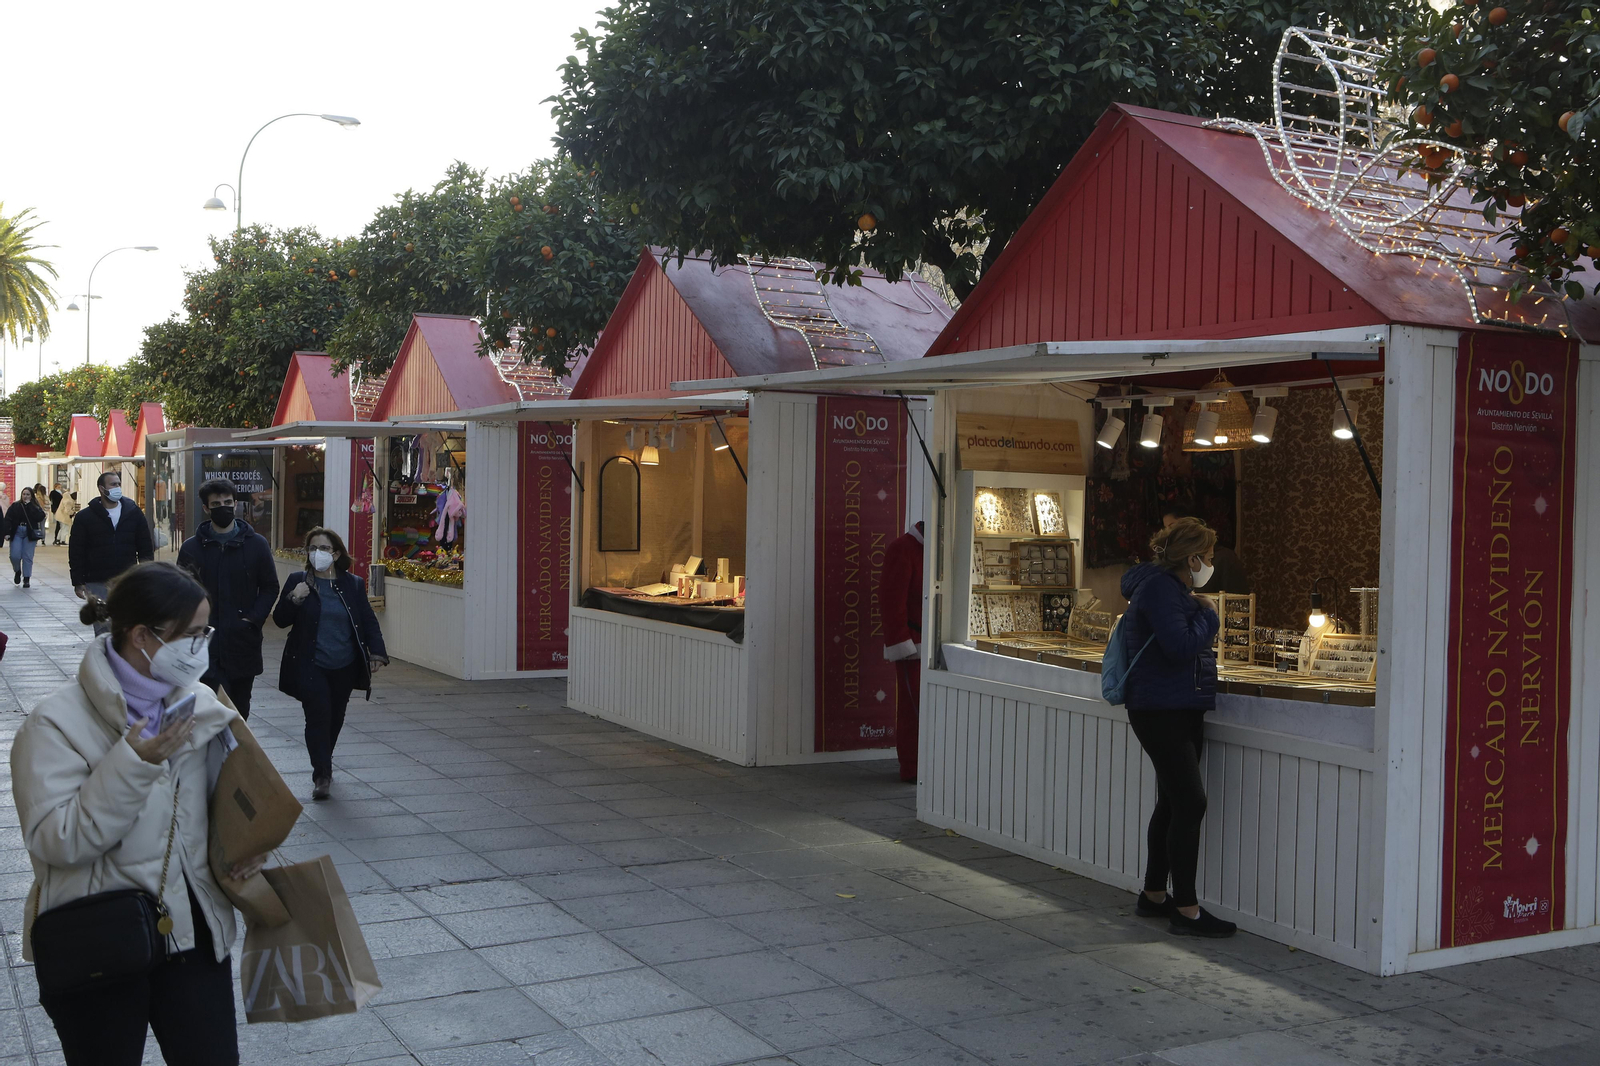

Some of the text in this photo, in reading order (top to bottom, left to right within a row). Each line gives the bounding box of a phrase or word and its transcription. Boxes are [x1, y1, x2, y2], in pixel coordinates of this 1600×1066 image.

[1477, 407, 1521, 419] AYUNTAMIENTO
[1531, 411, 1553, 420] SEVILLA
[1491, 421, 1537, 433] Distrito Nervión
[967, 435, 1075, 452] platadelmundo.com
[204, 470, 263, 481] WHISKY ESCOCÉS.
[234, 484, 266, 493] ERICANO.
[538, 465, 552, 641] MERCADO NAVIDEÑO
[841, 460, 861, 709] MERCADO NAVIDEÑO
[1482, 446, 1514, 871] MERCADO NAVIDEÑO
[1518, 567, 1545, 748] NERVIÓN
[241, 940, 356, 1012] ZARA
